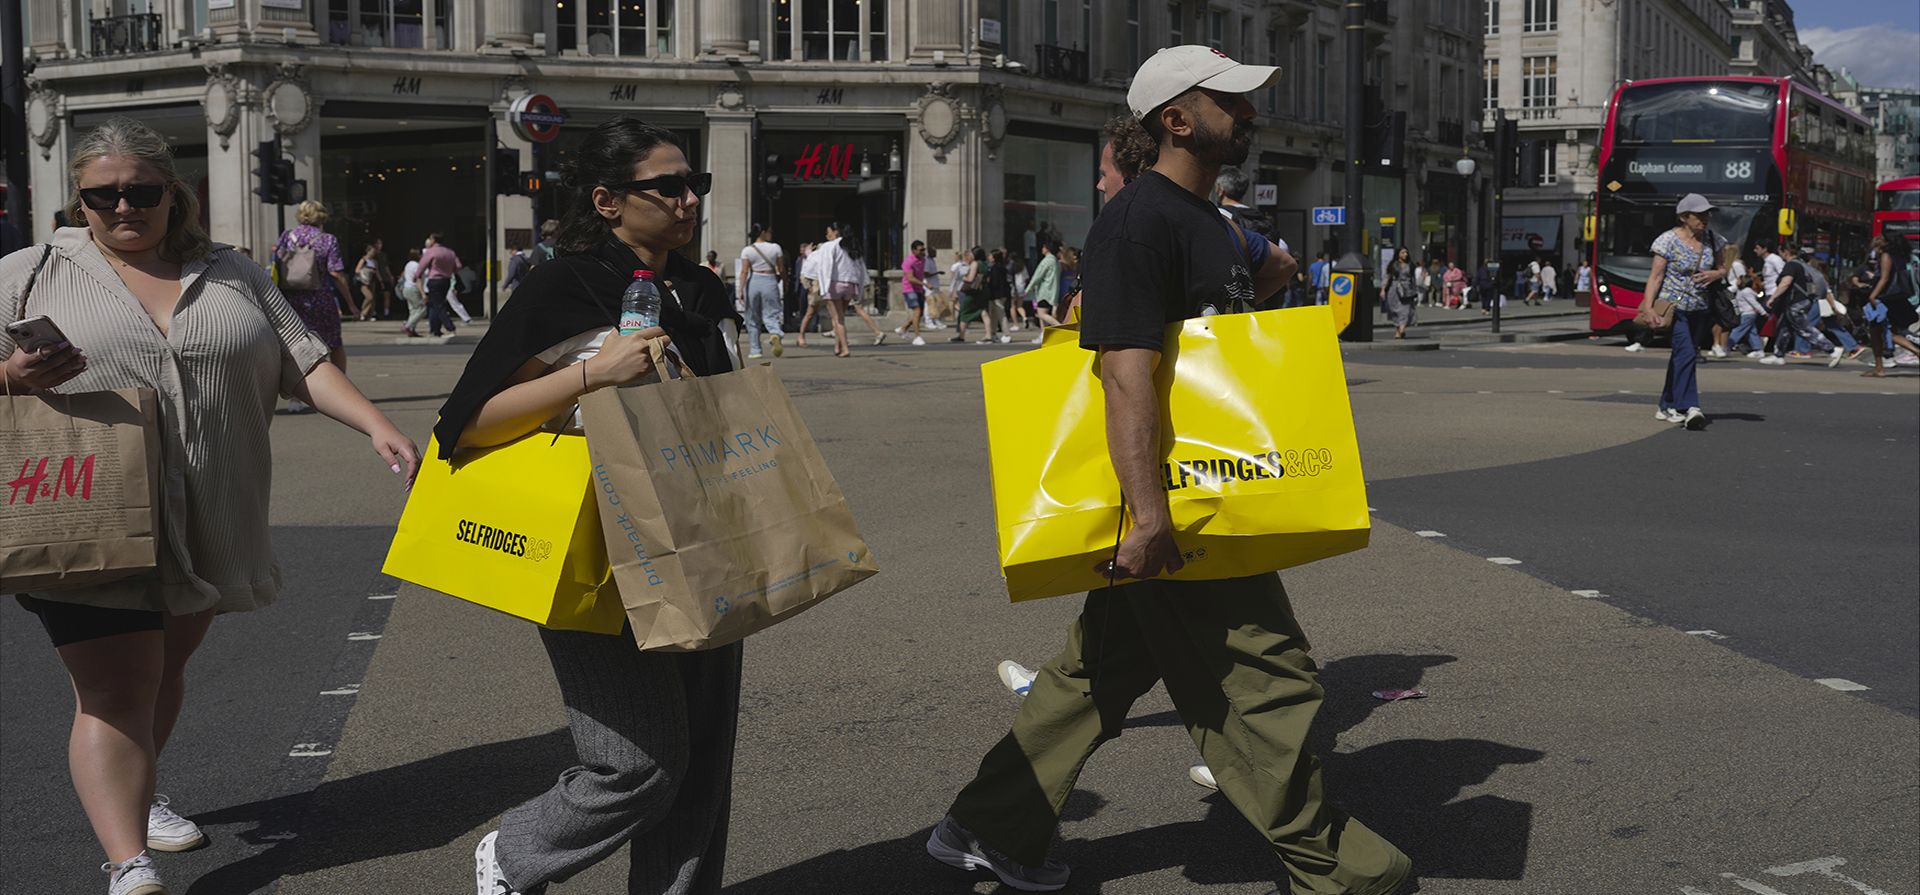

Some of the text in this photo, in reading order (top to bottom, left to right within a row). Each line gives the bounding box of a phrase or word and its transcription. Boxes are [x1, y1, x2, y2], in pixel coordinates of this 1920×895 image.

[392, 76, 421, 95] H&M
[816, 88, 843, 104] H&M
[793, 143, 855, 181] H&M
[1629, 161, 1751, 179] Clapham Common 88
[661, 425, 781, 471] PRIMARK
[7, 453, 96, 505] H&M
[731, 459, 777, 480] FEELING
[594, 463, 663, 586] primarkcom
